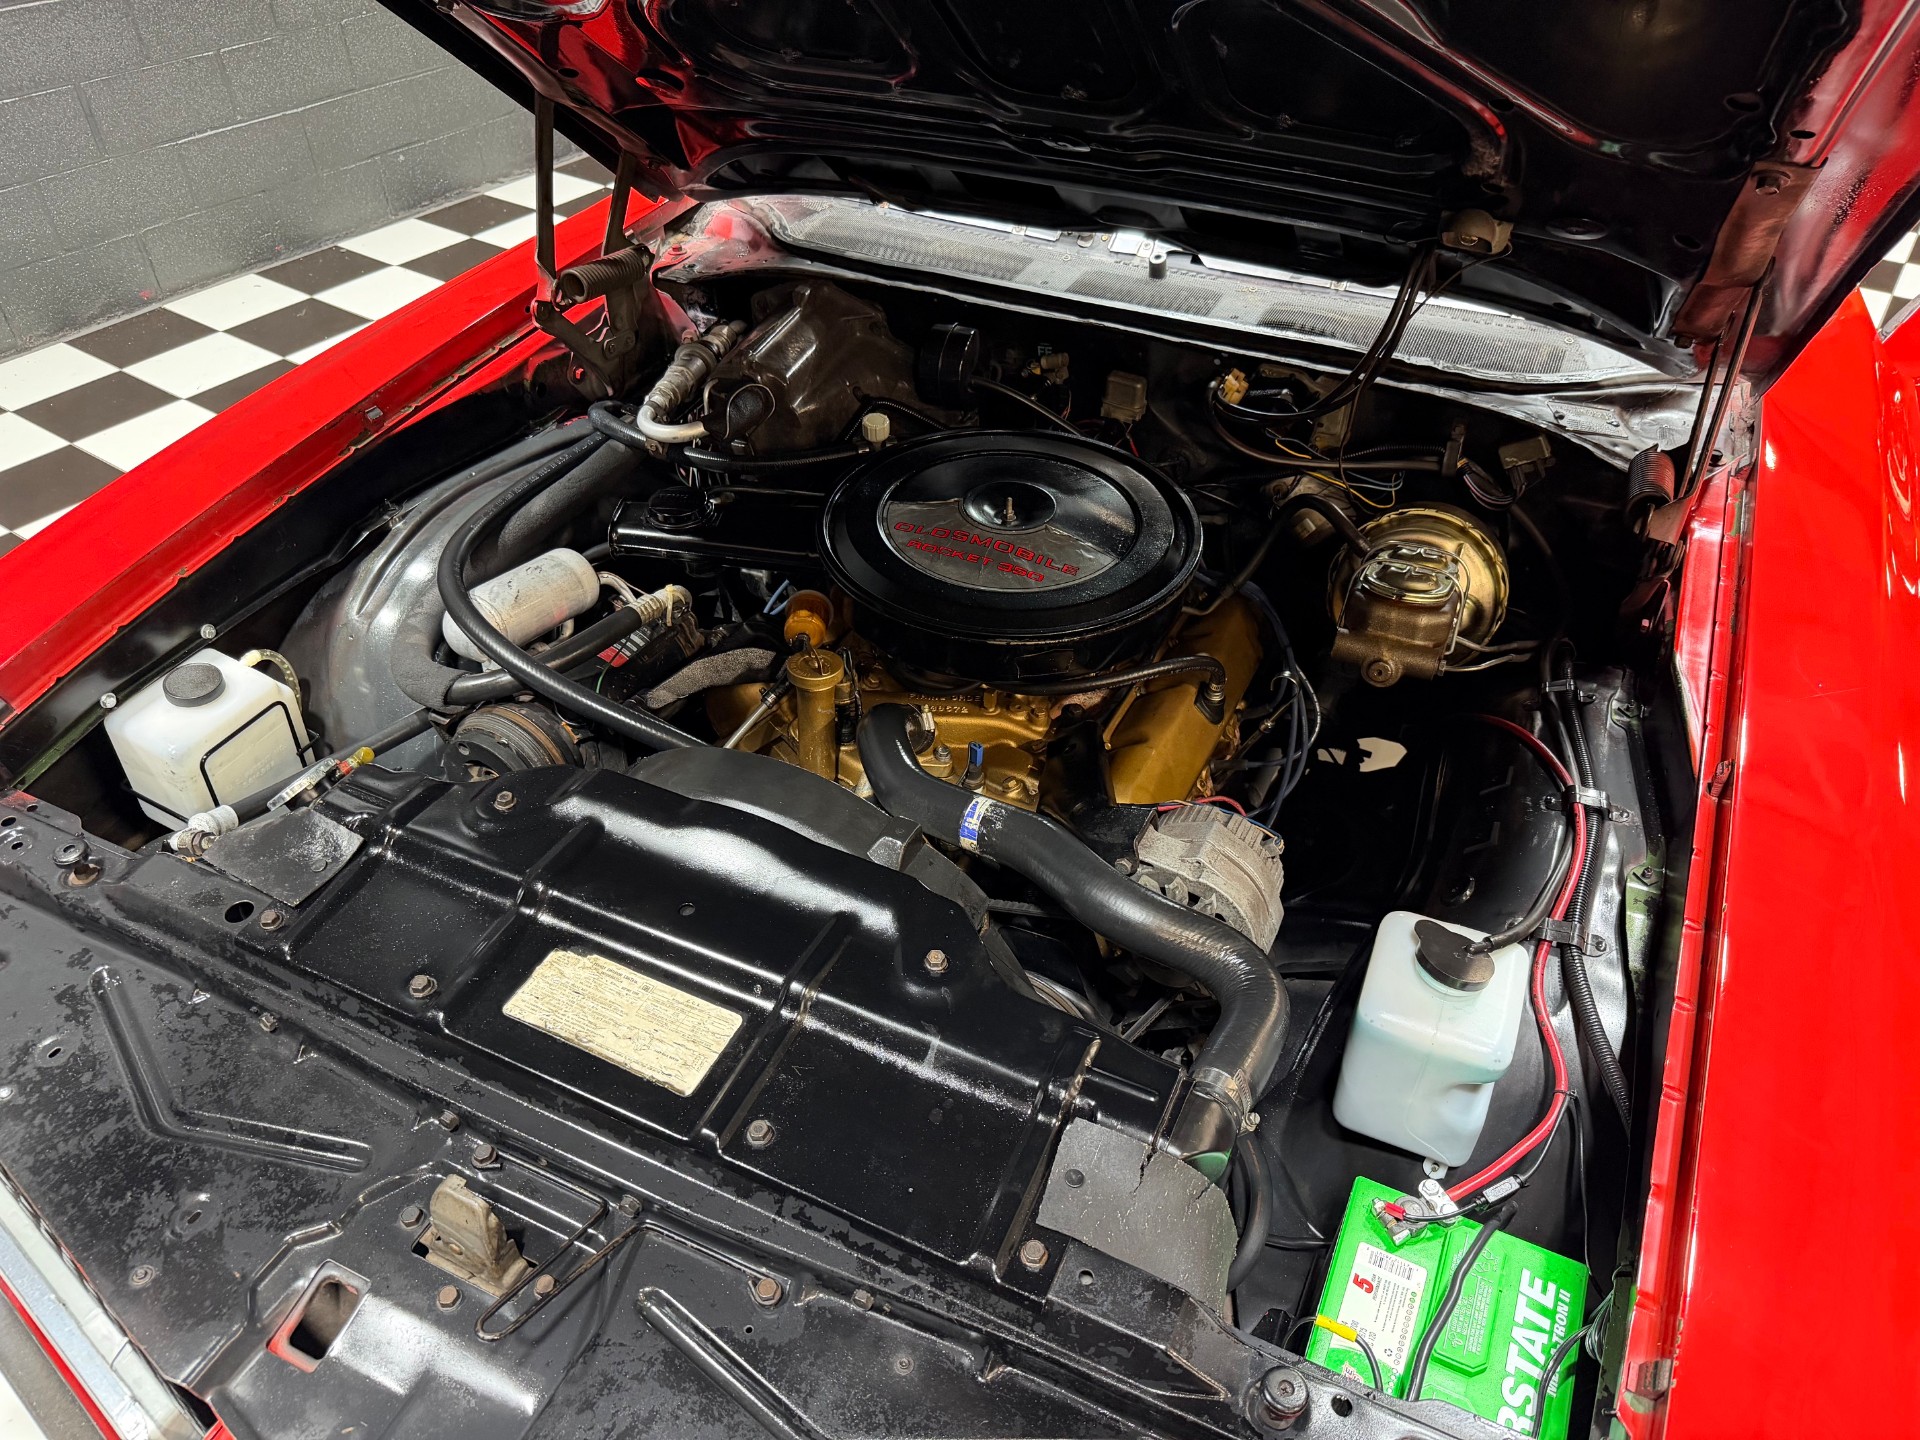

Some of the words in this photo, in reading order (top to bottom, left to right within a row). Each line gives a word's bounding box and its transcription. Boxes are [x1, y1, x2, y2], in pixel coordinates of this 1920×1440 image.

[894, 521, 1080, 576] OLDSMOBILE
[906, 539, 993, 568] ROCKET
[997, 561, 1045, 582] 350
[1352, 1272, 1375, 1295] 5
